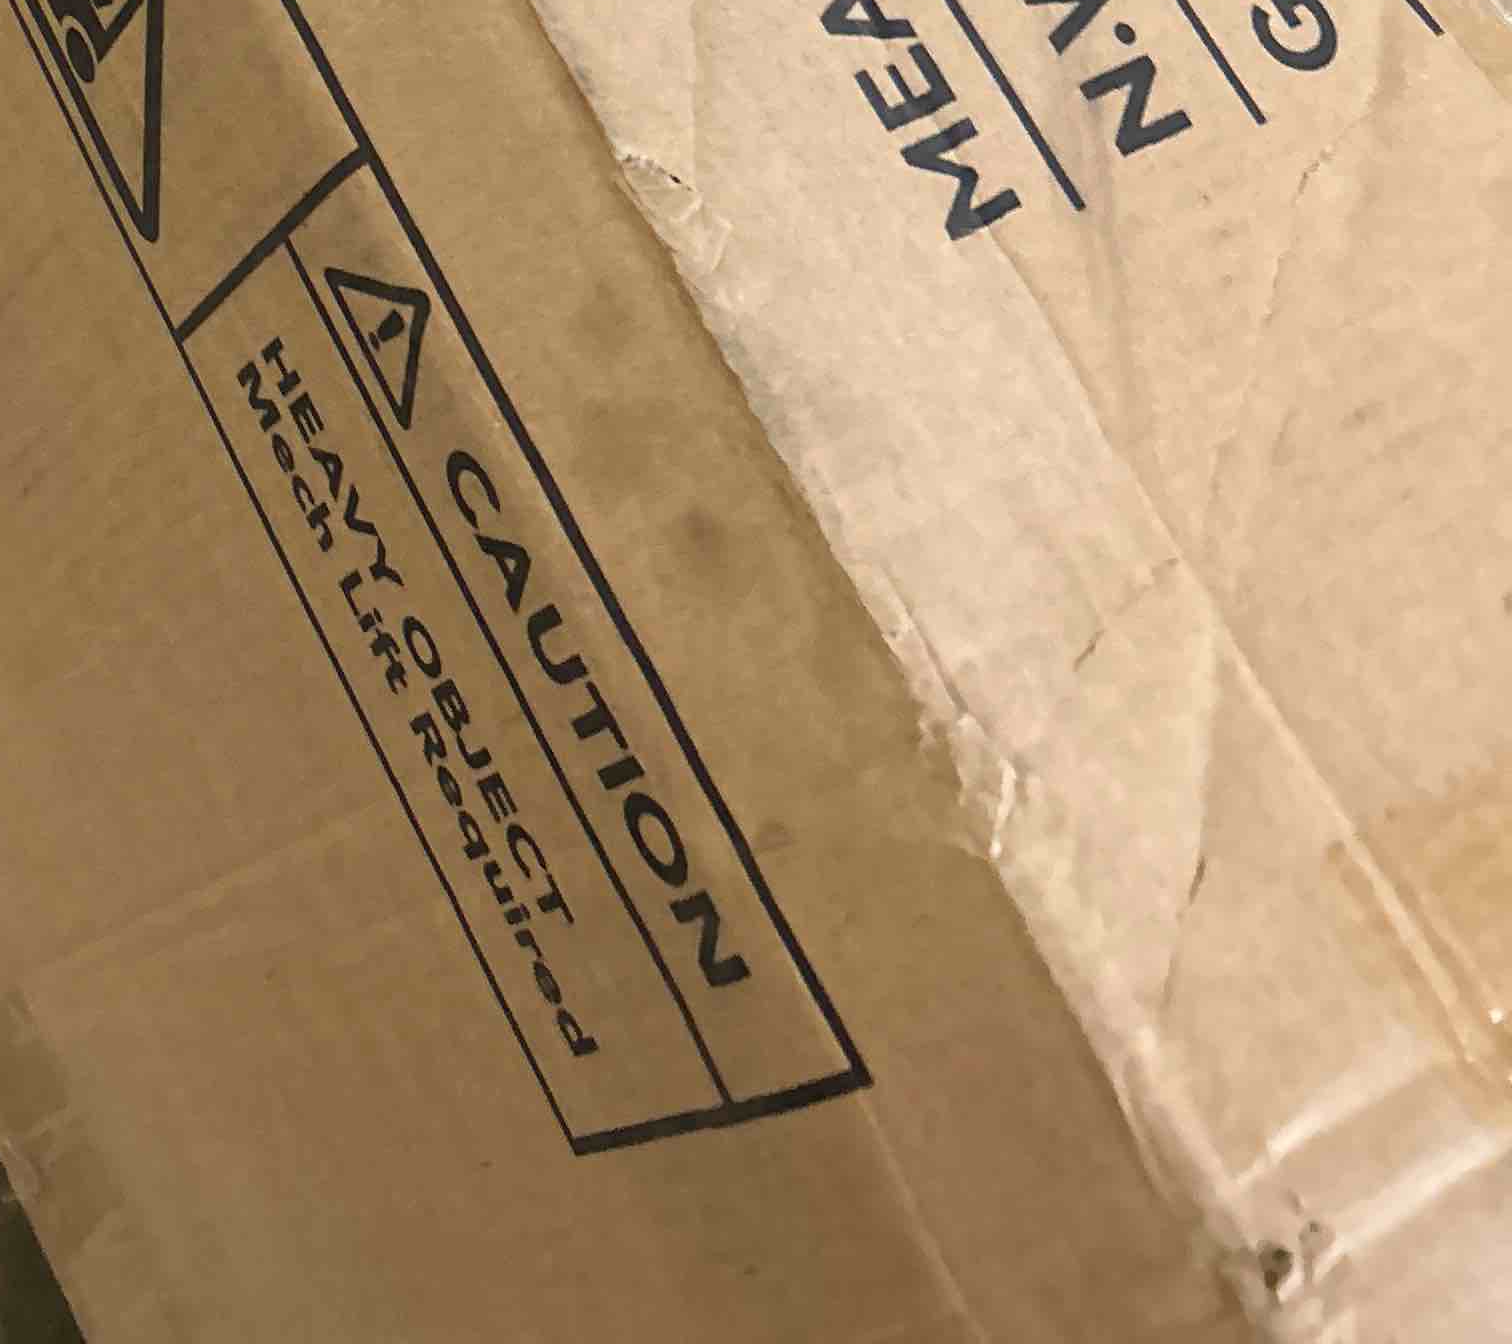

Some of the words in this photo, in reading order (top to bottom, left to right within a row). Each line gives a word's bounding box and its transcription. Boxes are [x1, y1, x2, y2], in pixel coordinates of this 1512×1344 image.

[235, 360, 333, 553] Mech
[339, 570, 409, 695] Lift
[408, 712, 599, 1059] Required
[261, 337, 405, 590] HEAVY
[399, 614, 574, 926] OBJECT
[444, 449, 751, 989] CAUTION
